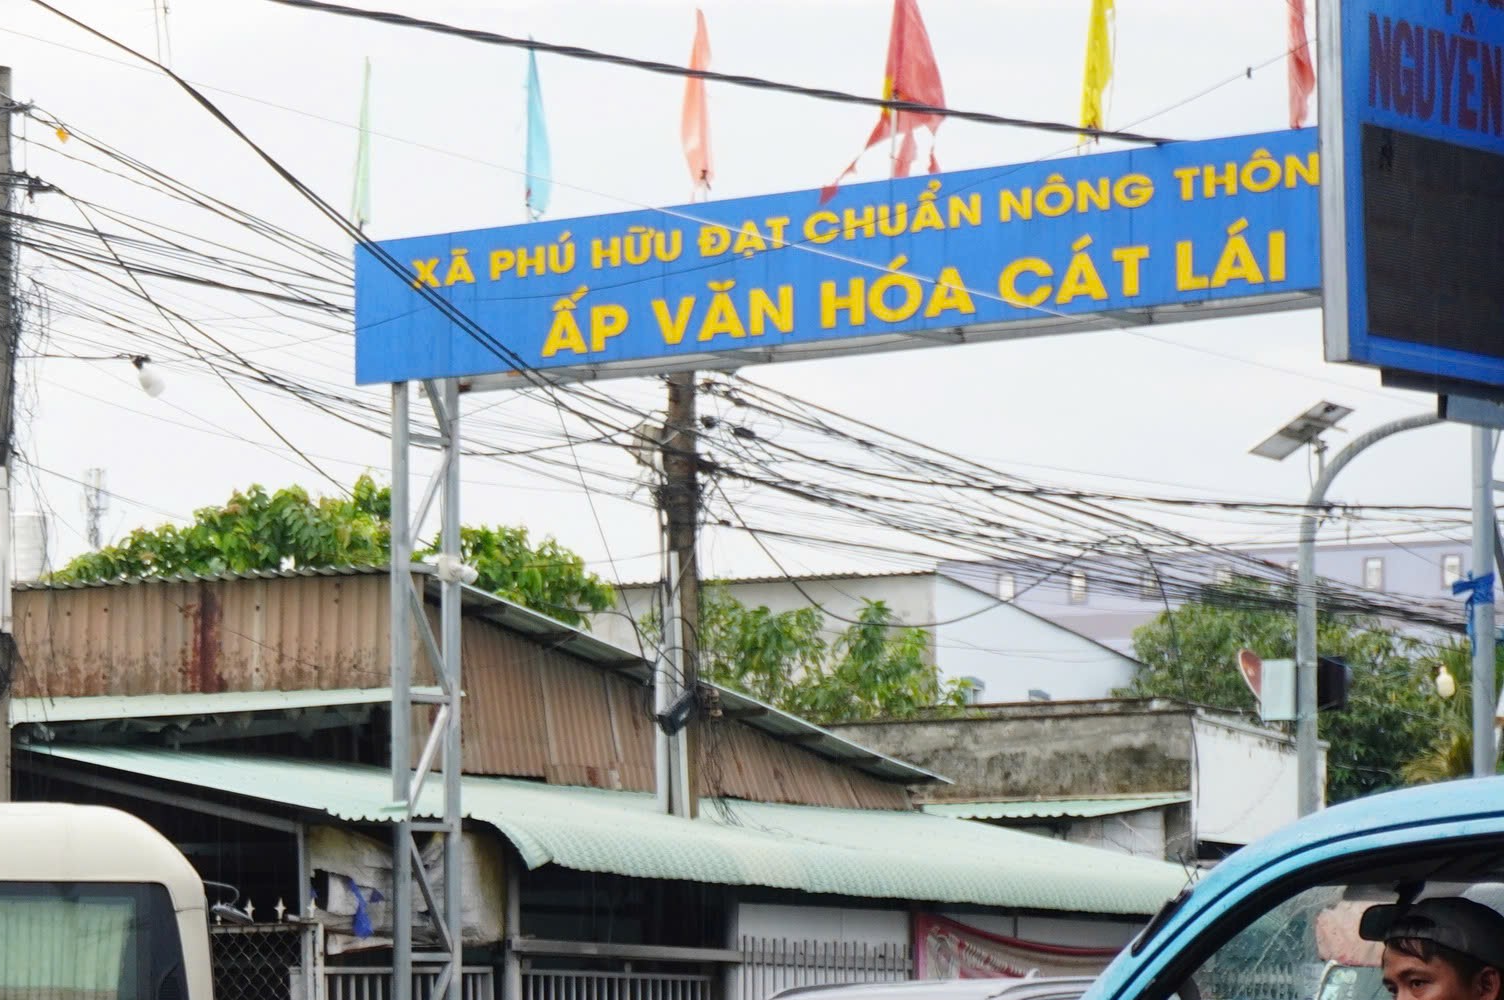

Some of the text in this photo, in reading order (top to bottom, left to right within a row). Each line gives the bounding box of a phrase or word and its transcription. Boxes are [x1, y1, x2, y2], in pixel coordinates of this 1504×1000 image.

[411, 148, 1320, 289] XÃ PHÚ HỮU ĐẠT CHUẨN NÔNG THÔN
[541, 217, 1287, 358] ẤP VĂN HÓA CÁT LÁI
